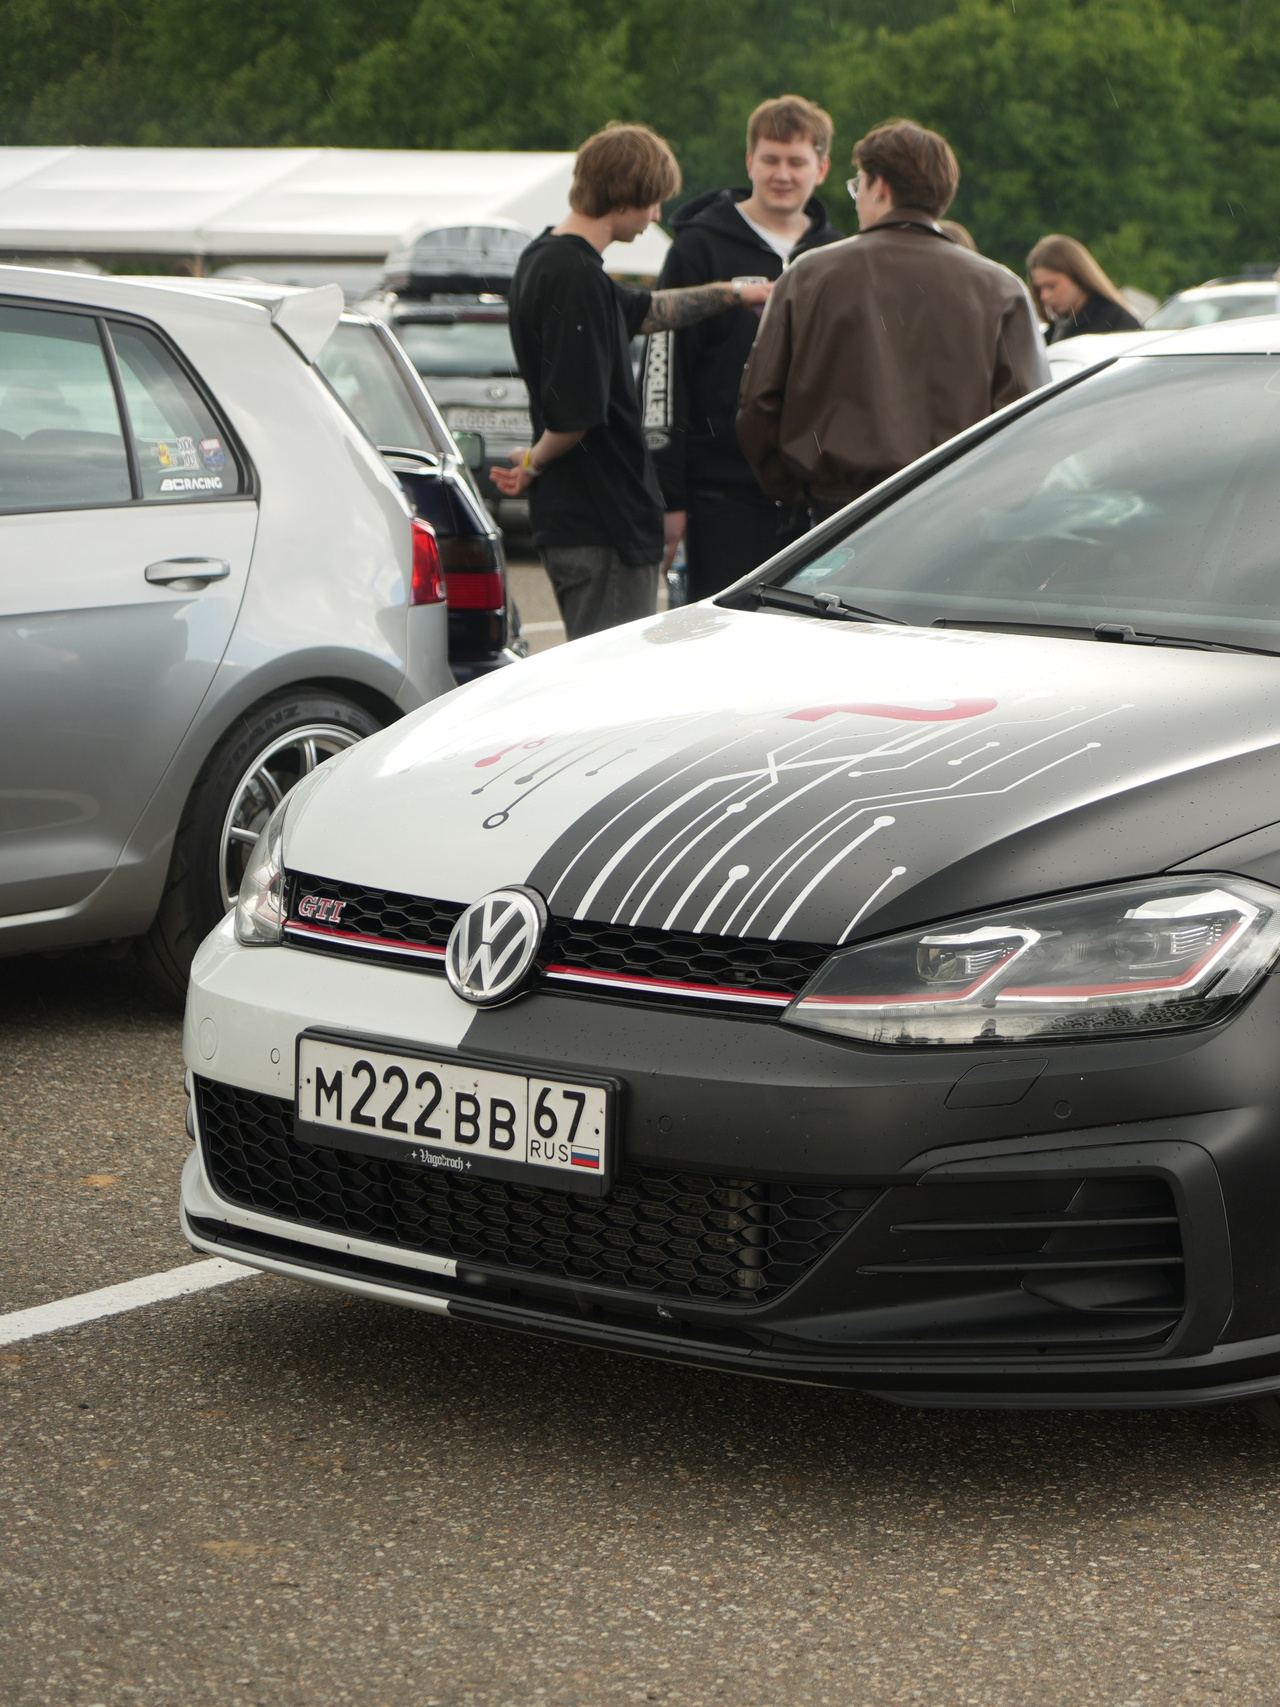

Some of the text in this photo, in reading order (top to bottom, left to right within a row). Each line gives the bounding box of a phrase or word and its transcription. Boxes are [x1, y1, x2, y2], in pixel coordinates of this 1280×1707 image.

[643, 330, 667, 428] BETBOOM
[298, 895, 347, 924] GTI
[534, 1086, 586, 1143] 67
[530, 1139, 569, 1163] RUS
